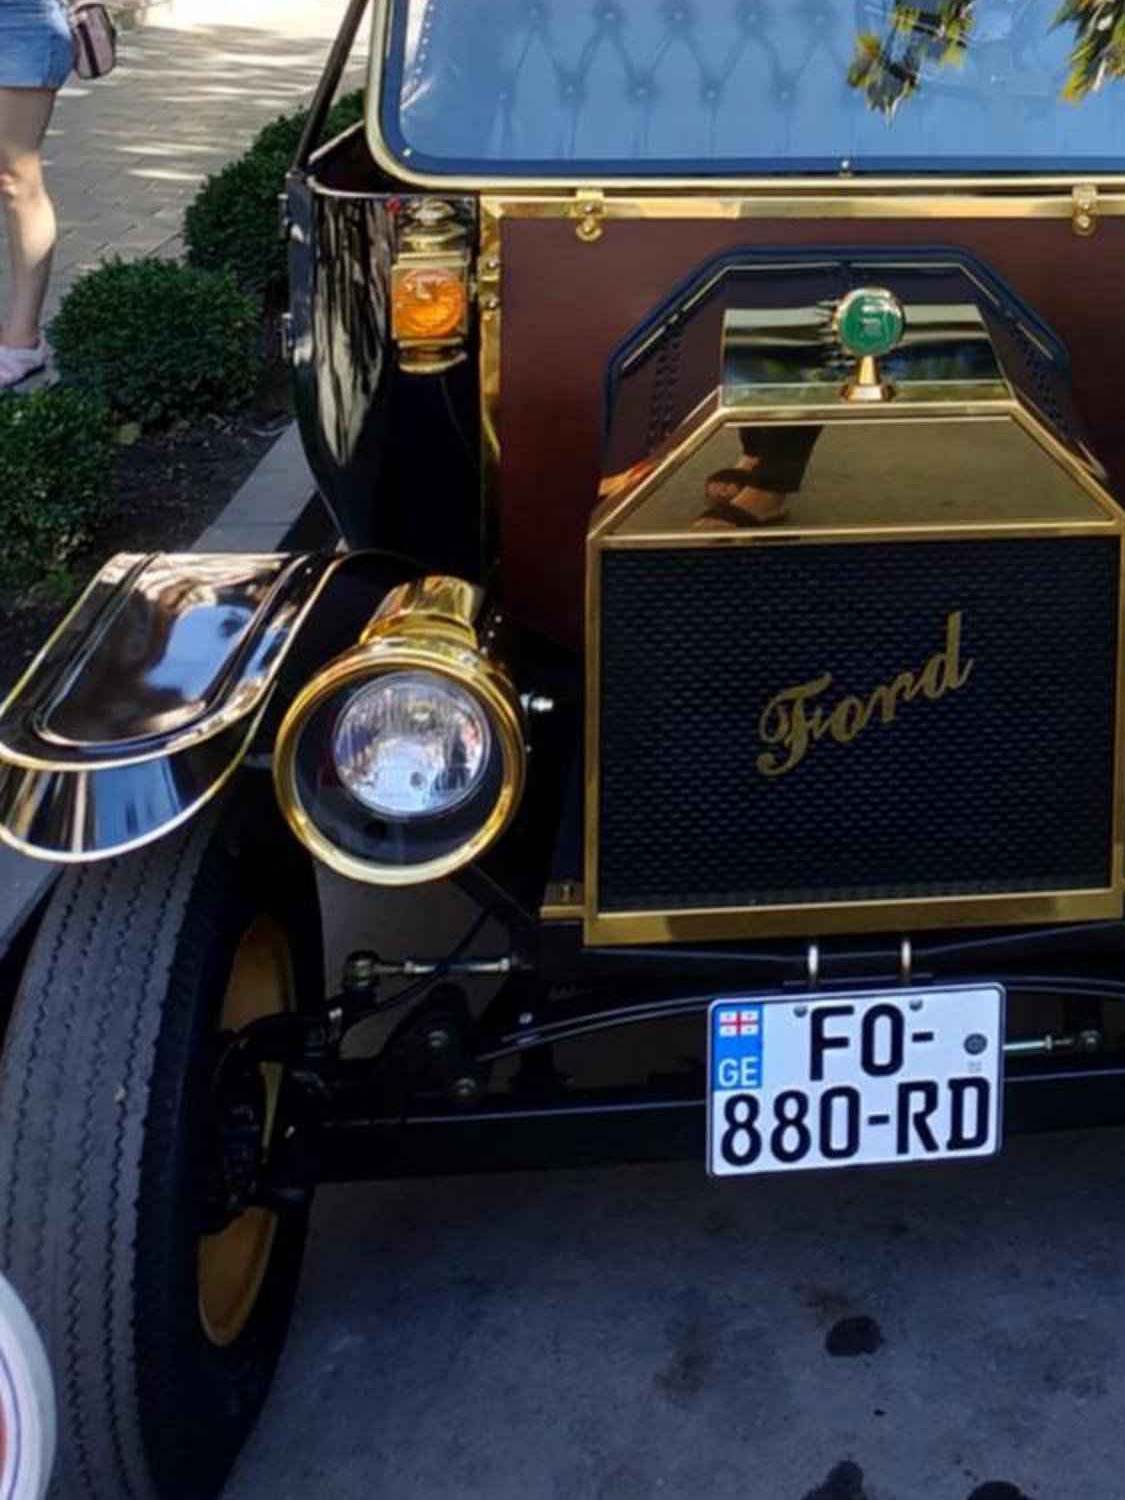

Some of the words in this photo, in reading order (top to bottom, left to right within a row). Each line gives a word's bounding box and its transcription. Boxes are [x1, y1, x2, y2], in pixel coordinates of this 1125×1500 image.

[756, 611, 975, 776] Ford
[718, 1056, 759, 1088] GE
[720, 1076, 991, 1167] 880-RD
